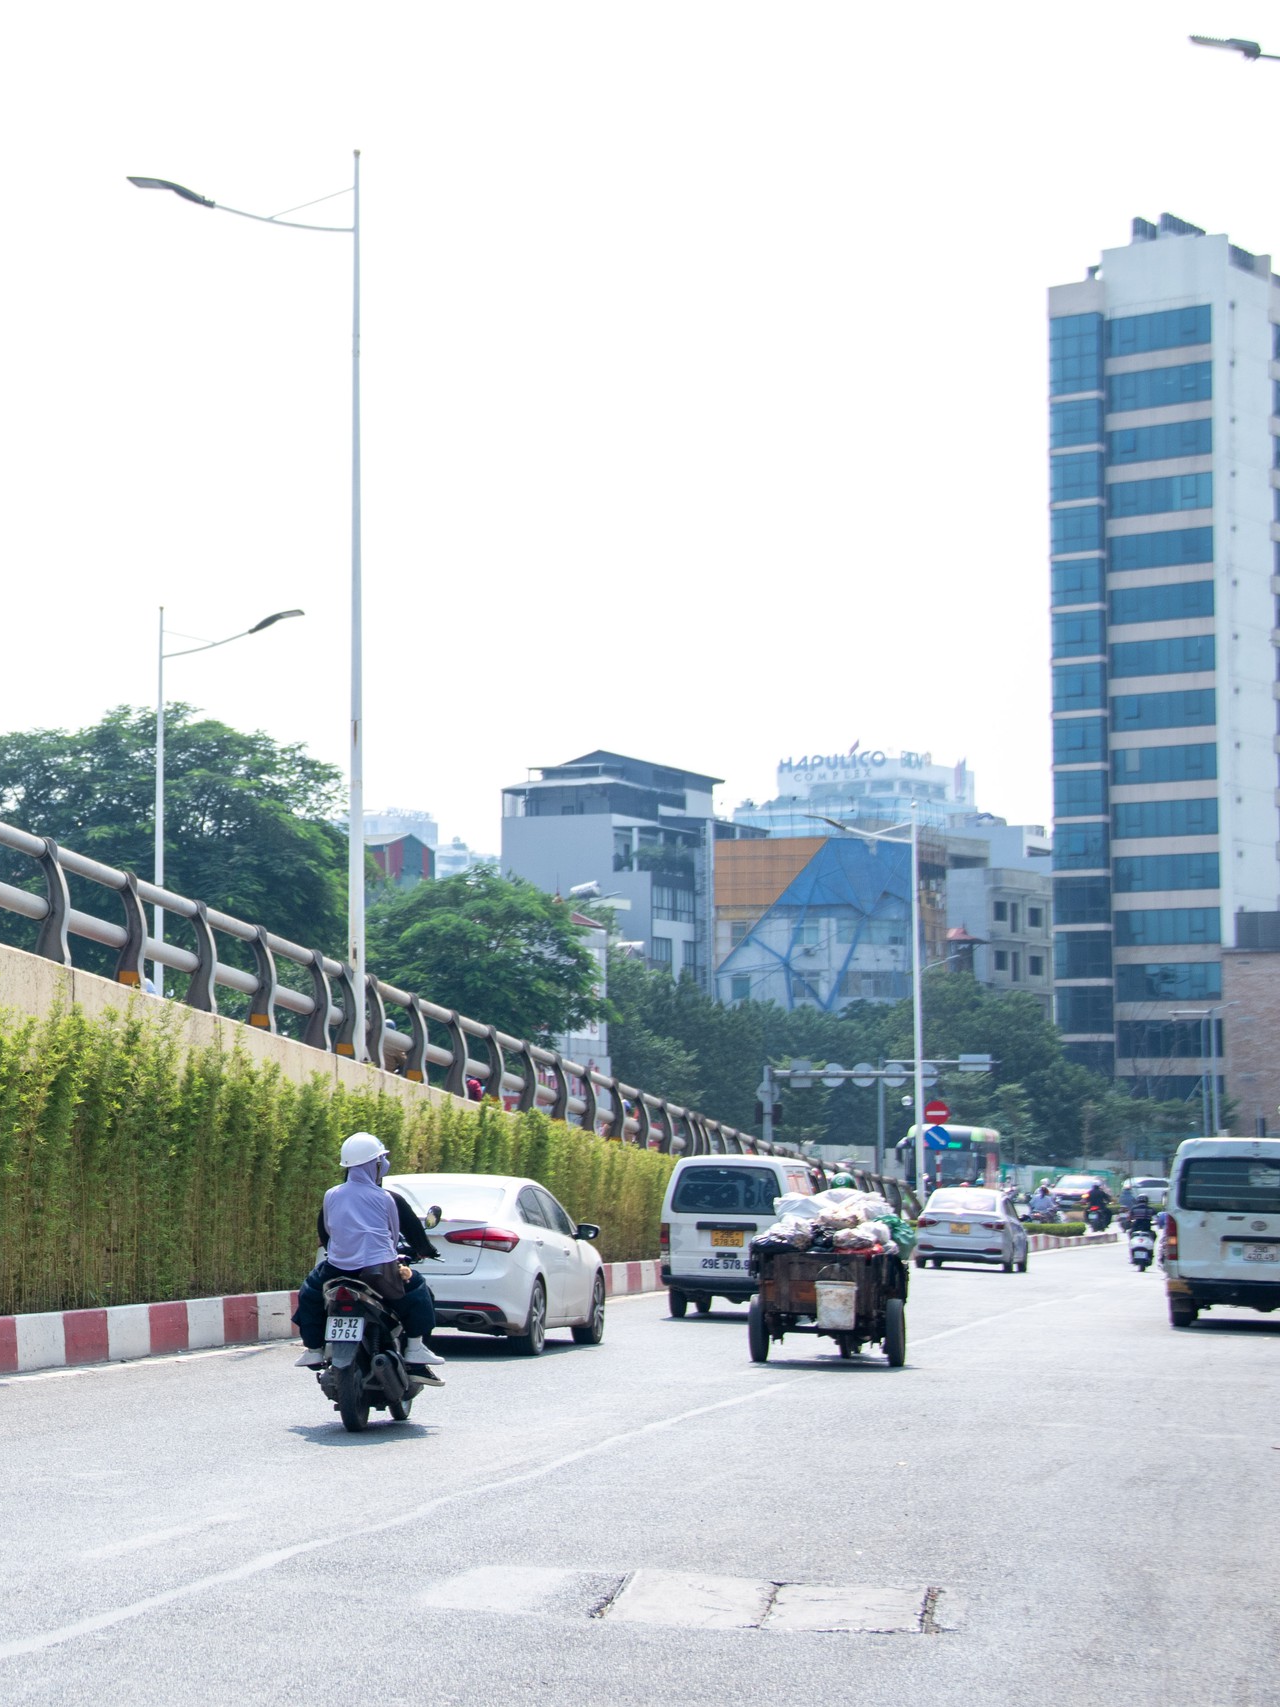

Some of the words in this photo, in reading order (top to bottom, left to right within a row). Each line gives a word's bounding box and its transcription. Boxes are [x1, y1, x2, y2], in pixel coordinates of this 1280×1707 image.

[793, 768, 871, 782] COMPLEX
[702, 1258, 720, 1269] 29E
[722, 1259, 751, 1270] 578.9
[332, 1318, 358, 1328] 30-X2
[331, 1328, 357, 1339] 9764
